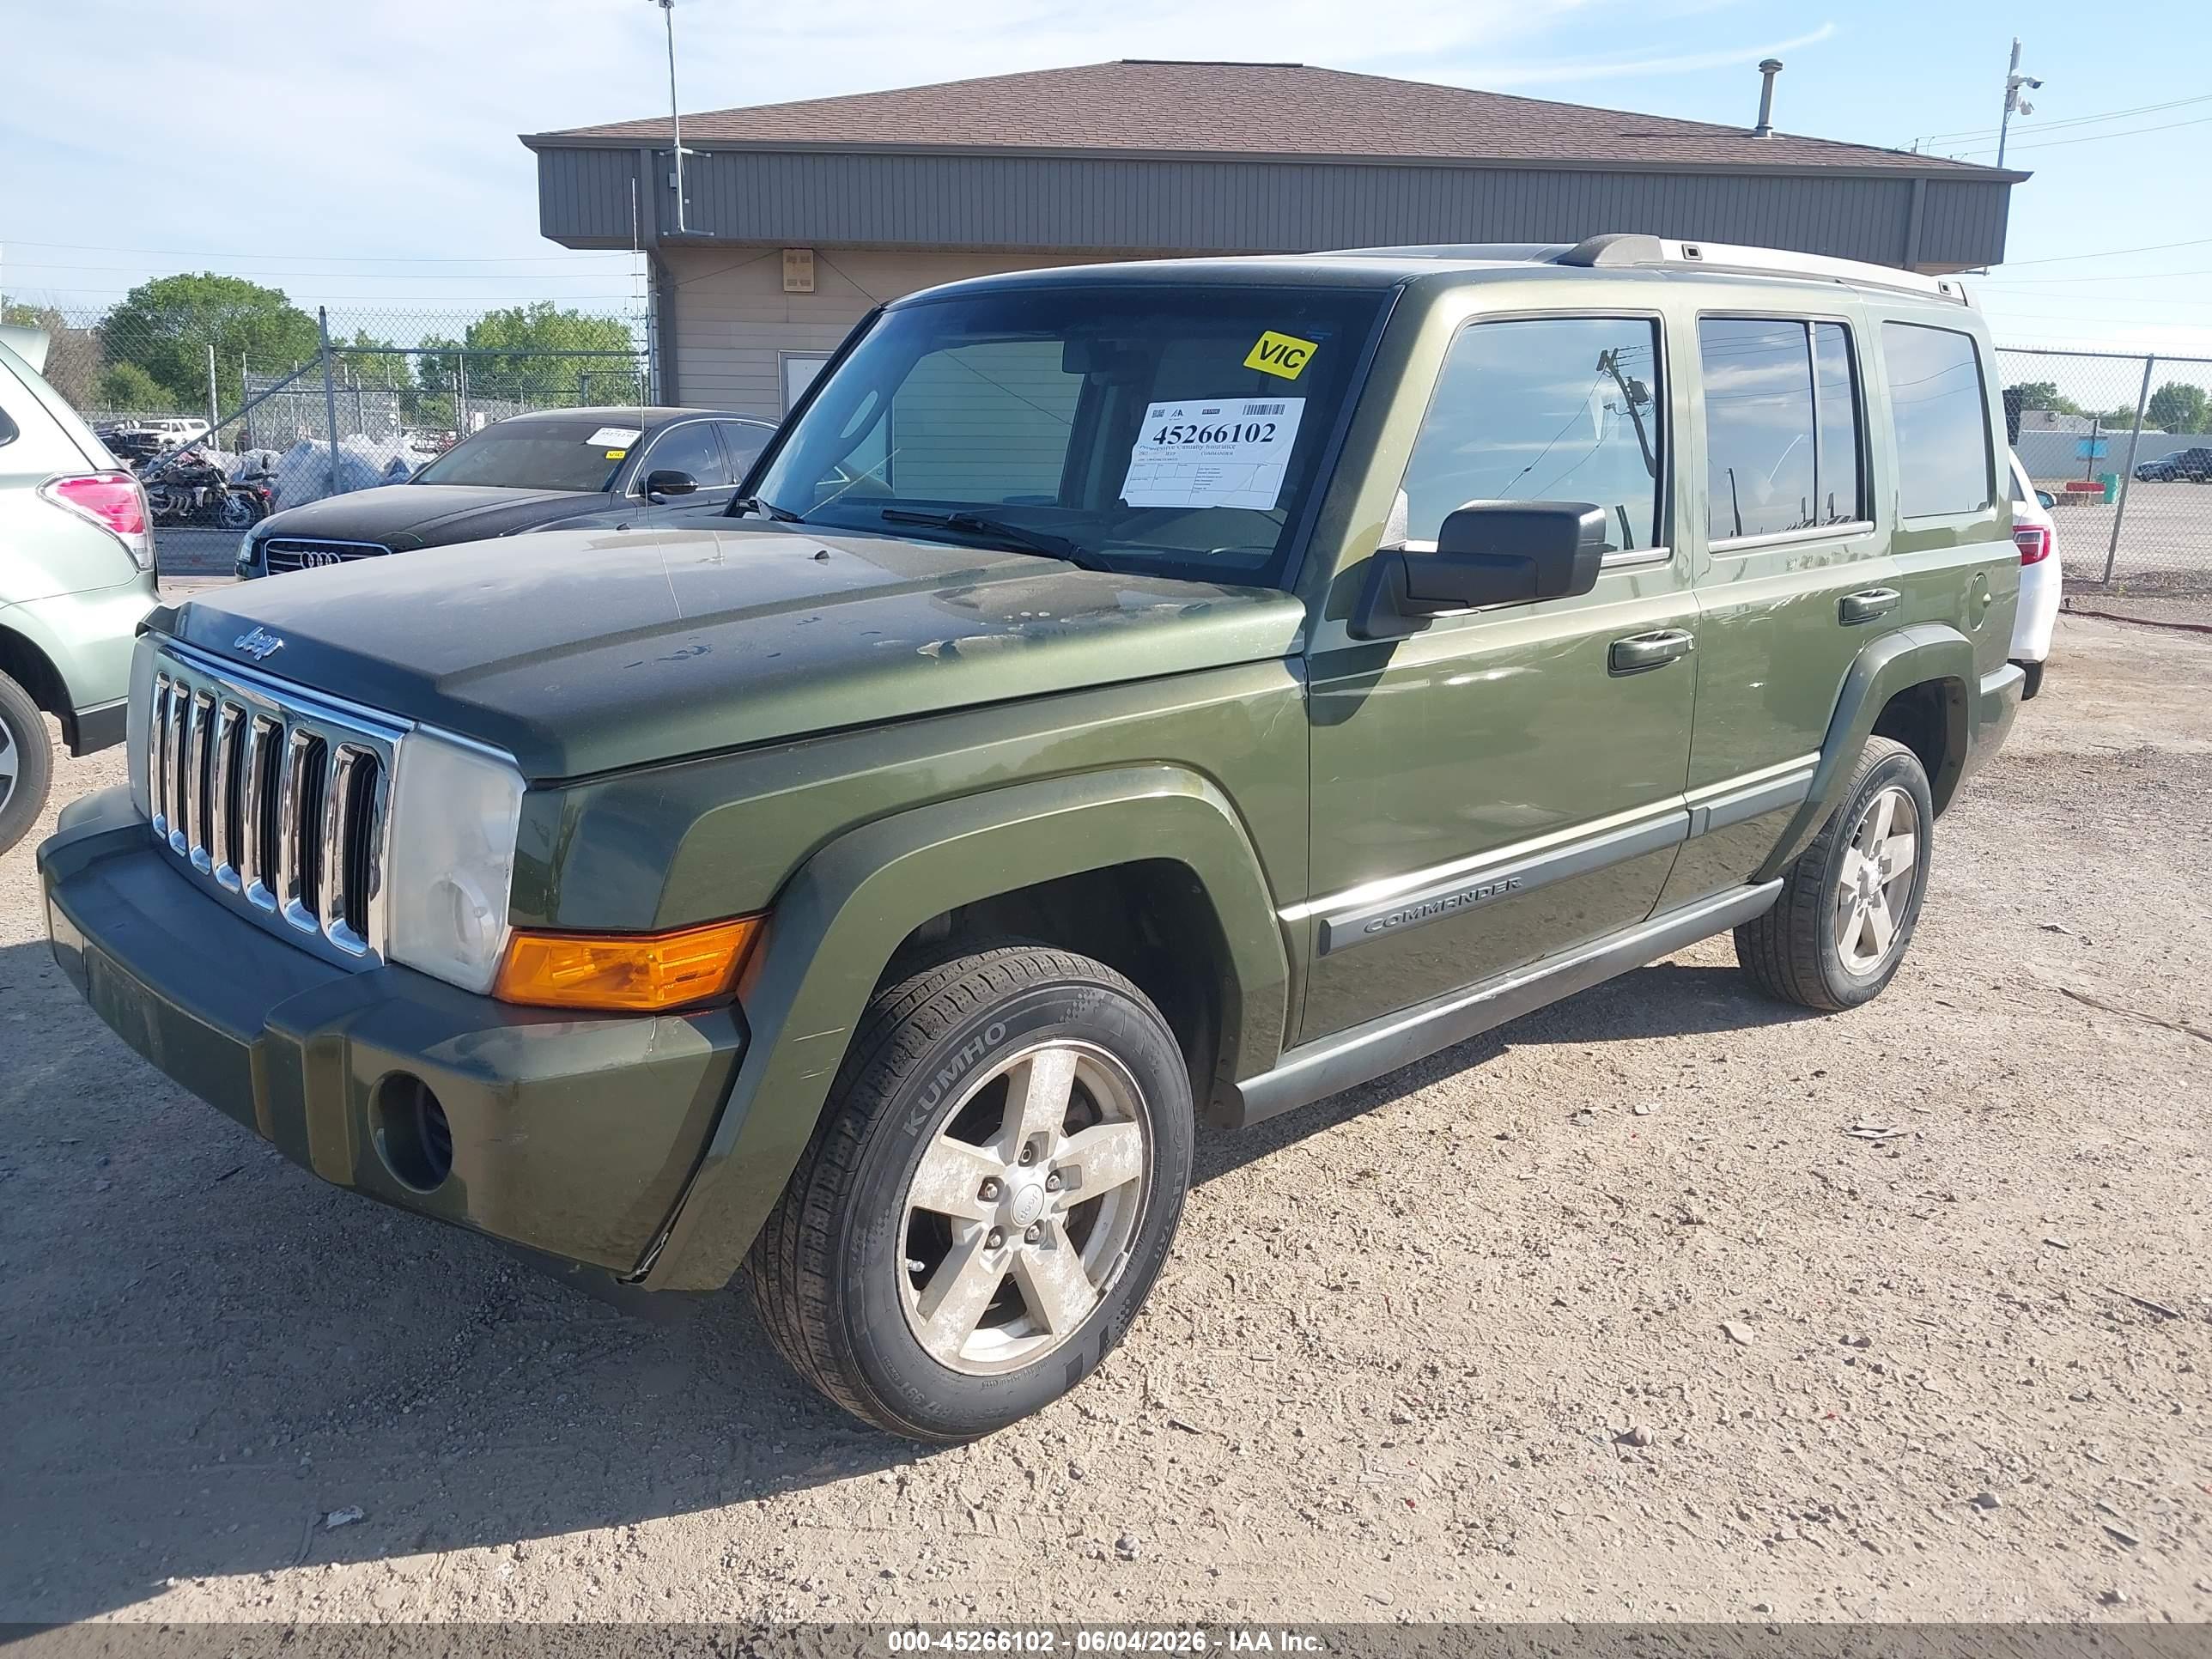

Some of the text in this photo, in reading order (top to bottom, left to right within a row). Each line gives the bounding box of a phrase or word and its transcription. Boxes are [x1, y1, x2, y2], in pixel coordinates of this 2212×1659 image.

[1259, 339, 1306, 368] VIC
[1152, 422, 1277, 445] 45266102
[234, 626, 283, 660] Jeep
[1364, 877, 1523, 933] COMMANDER
[902, 1022, 1006, 1138] KUMHO
